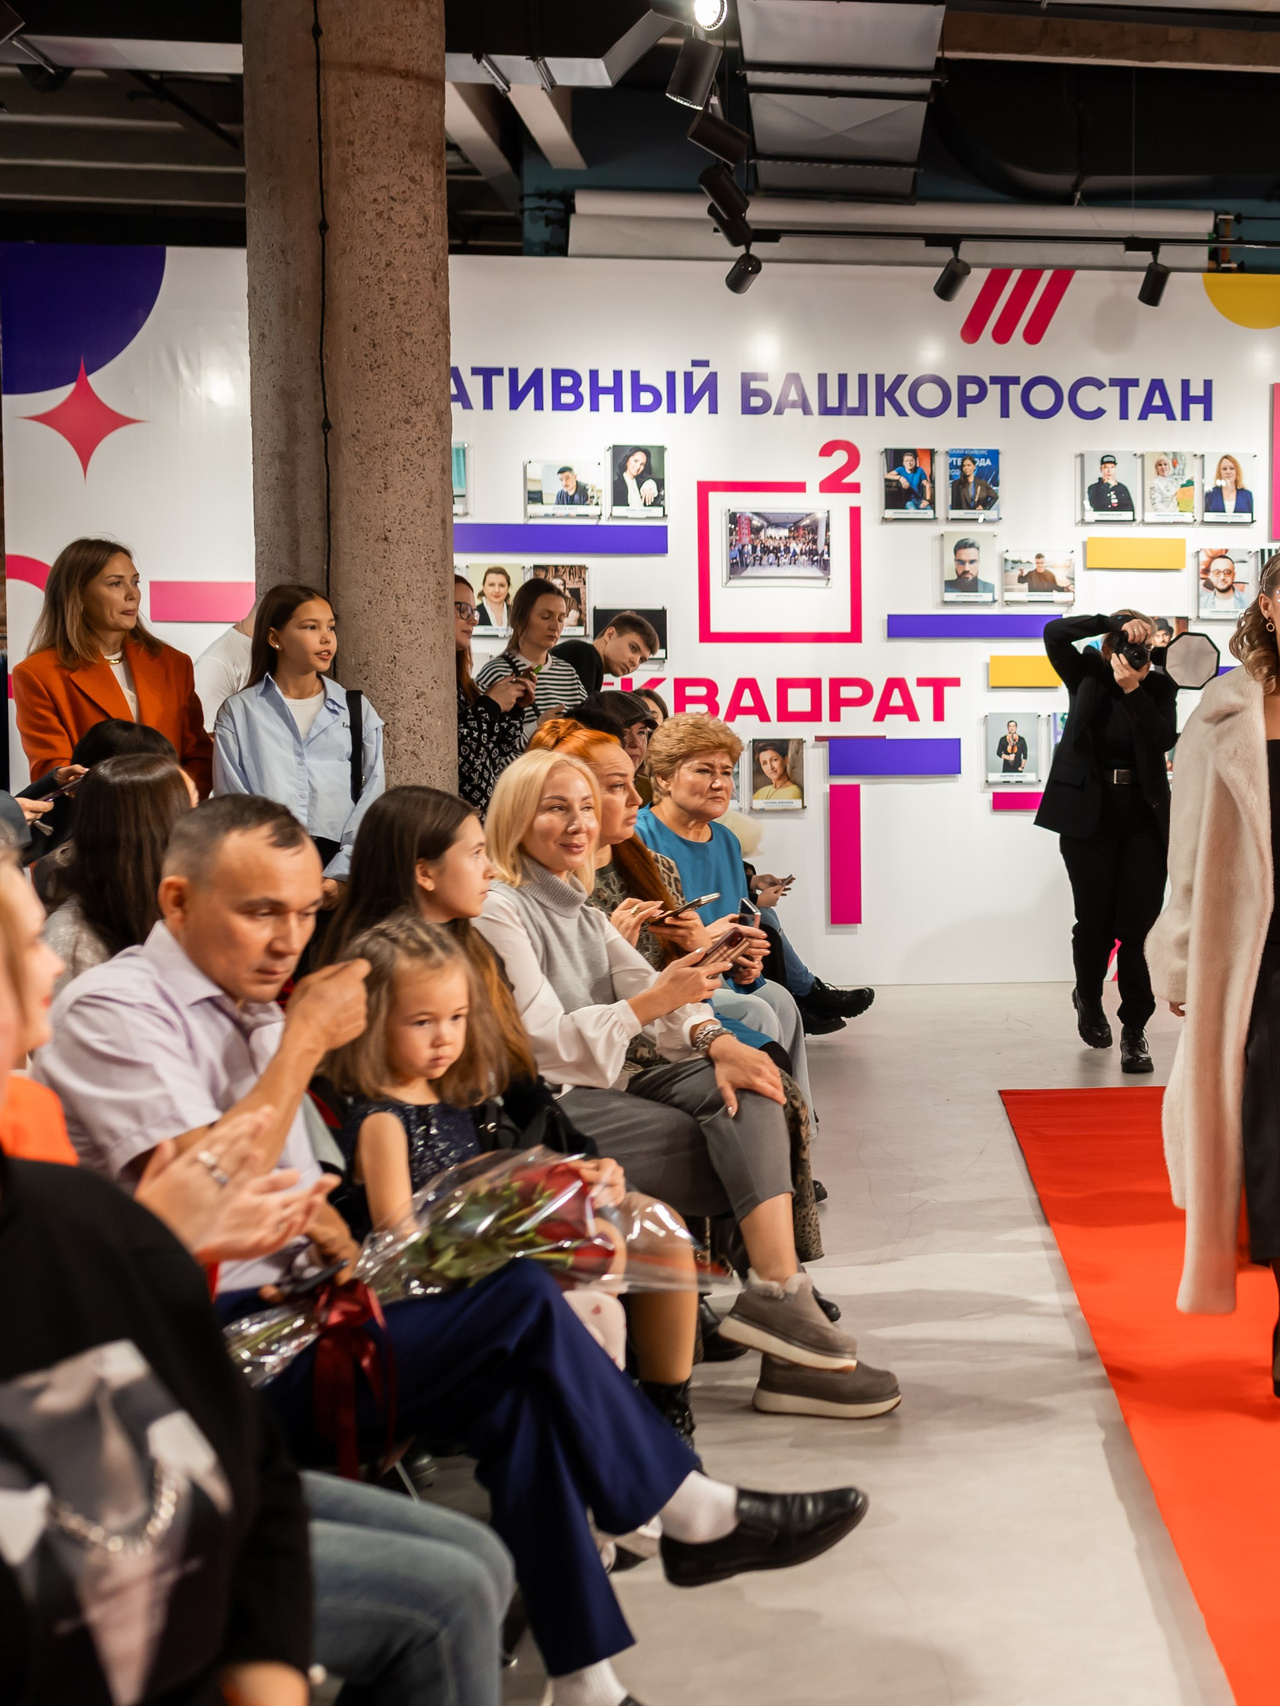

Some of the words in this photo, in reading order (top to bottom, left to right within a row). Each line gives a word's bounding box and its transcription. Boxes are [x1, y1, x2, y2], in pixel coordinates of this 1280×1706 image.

[450, 359, 718, 415] АТИВНЫЙ
[741, 371, 1213, 422] БАШКОРТОСТАН
[818, 439, 861, 493] 2
[949, 457, 962, 466] РТЕ
[621, 677, 961, 723] ВАДРАТ
